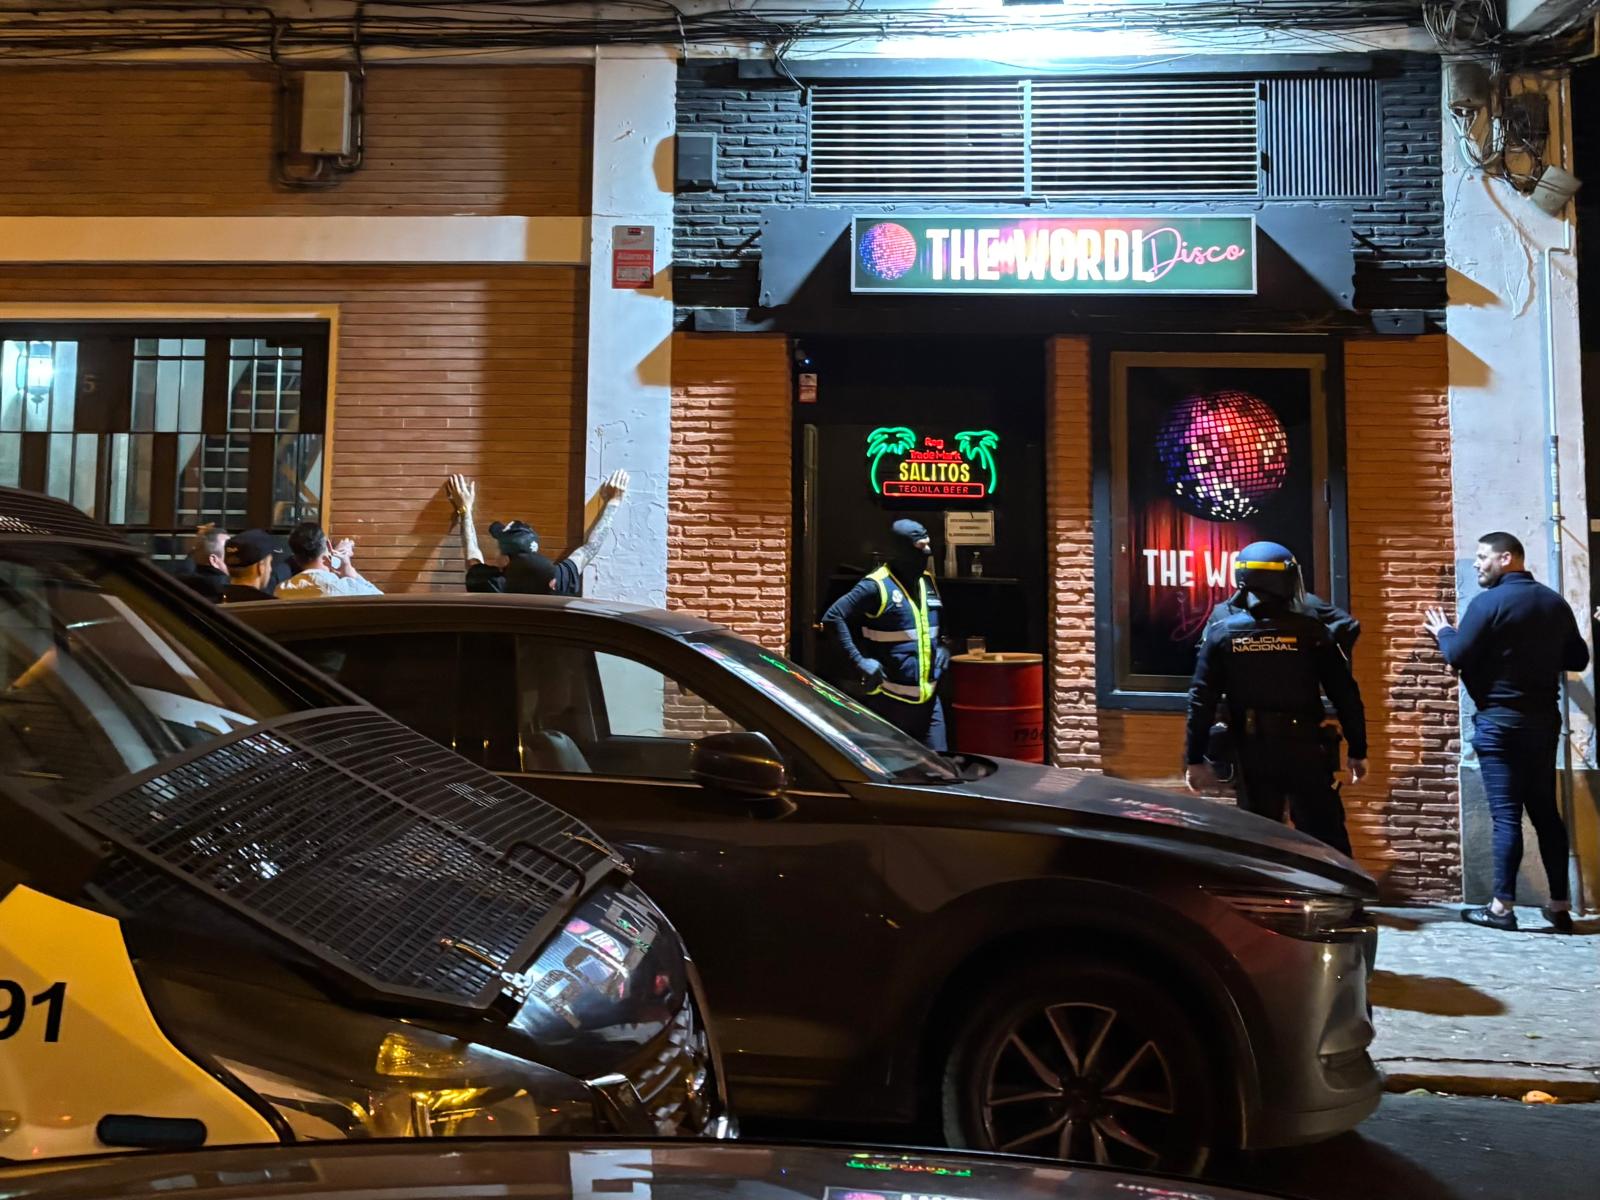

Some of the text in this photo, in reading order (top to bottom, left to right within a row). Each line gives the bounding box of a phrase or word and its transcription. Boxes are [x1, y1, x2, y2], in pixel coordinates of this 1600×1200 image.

[926, 227, 1246, 283] THE WORDL Disco
[924, 436, 944, 450] Reg
[899, 462, 970, 483] SALITOS
[898, 485, 969, 495] TEQUILA BEER
[1142, 548, 1195, 587] THE
[1232, 643, 1299, 653] NACIONAL
[0, 979, 67, 1043] 91
